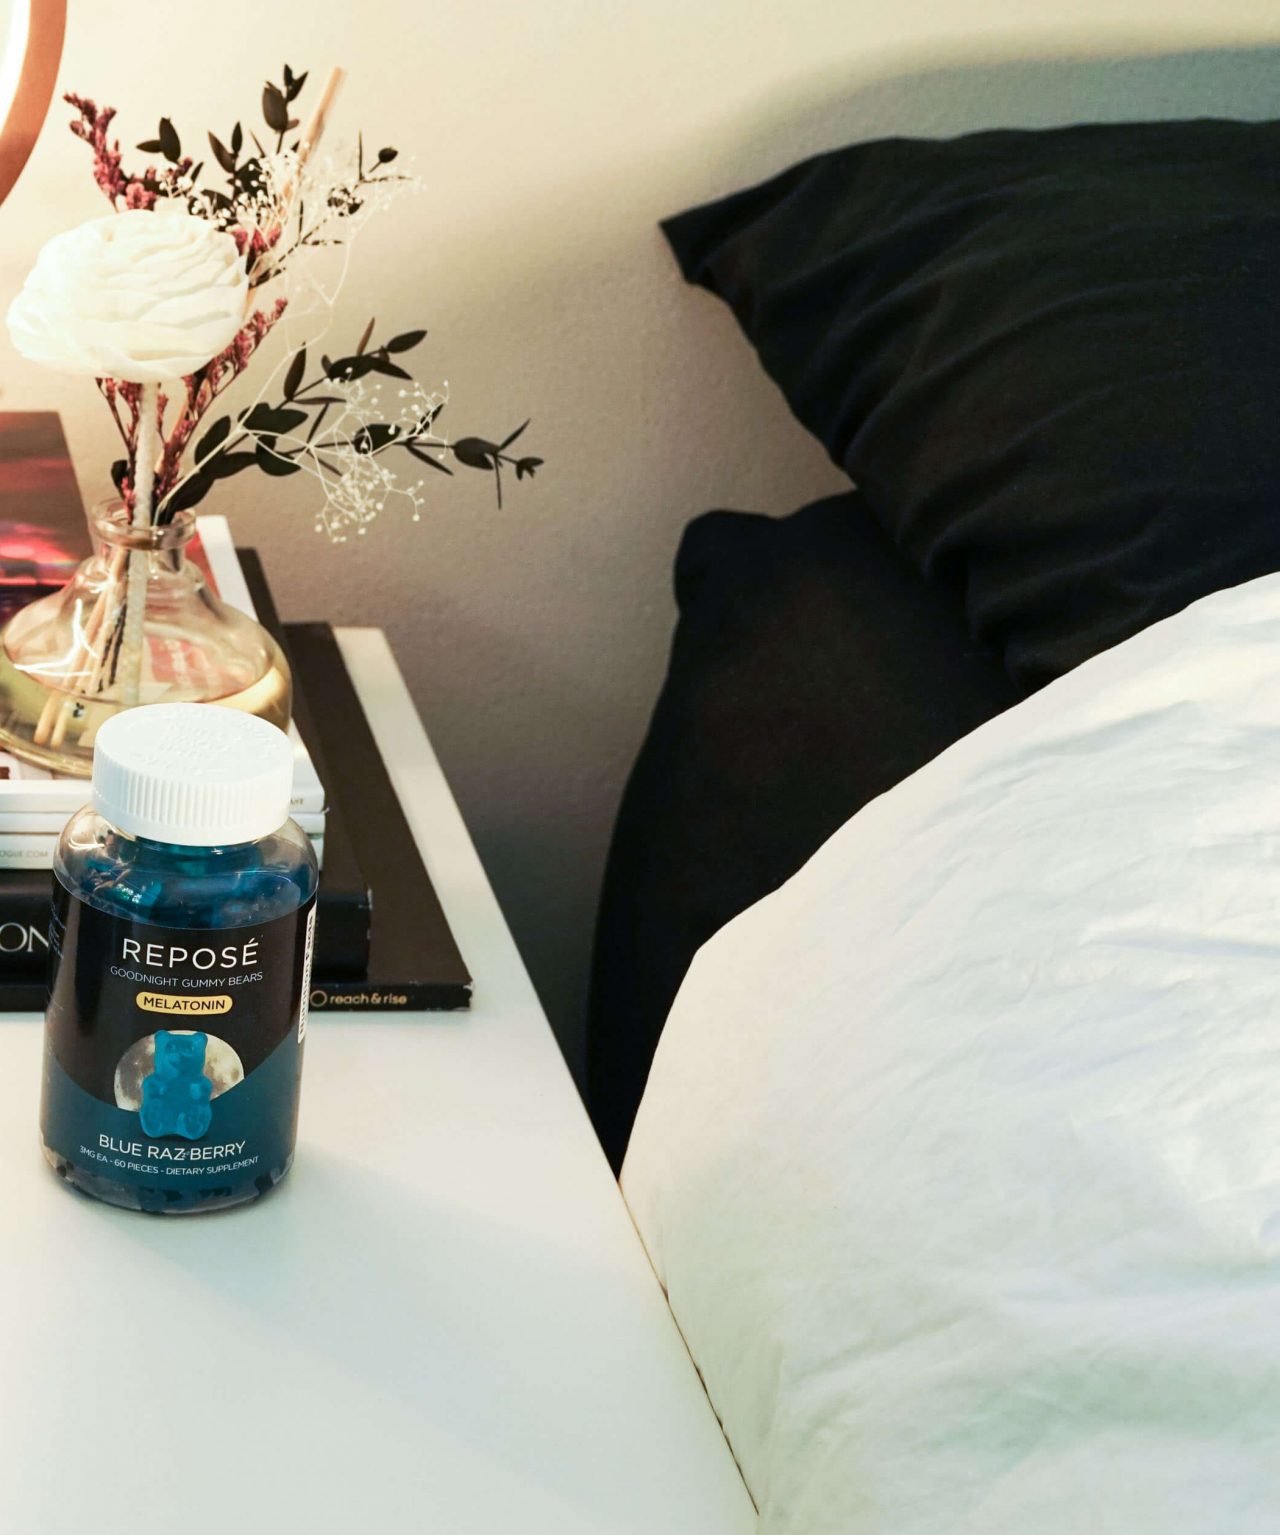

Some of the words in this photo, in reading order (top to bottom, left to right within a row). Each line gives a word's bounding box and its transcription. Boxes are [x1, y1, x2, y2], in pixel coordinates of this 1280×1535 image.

[122, 937, 260, 970] REPOSÉ
[110, 965, 179, 988] GOODNIGHT
[181, 977, 226, 989] GUMMY
[228, 971, 264, 987] BEARS
[142, 996, 226, 1011] MELATONIN
[330, 993, 369, 1005] reach
[370, 992, 382, 1005] &
[383, 993, 408, 1005] rise
[99, 1133, 143, 1157] BLUE
[80, 1145, 96, 1159] 3MG
[96, 1152, 109, 1163] EA
[114, 1158, 126, 1168] 60
[127, 1161, 159, 1174] PIECES
[166, 1167, 205, 1176] DIETARY
[206, 1155, 260, 1175] SUPPLEMENT
